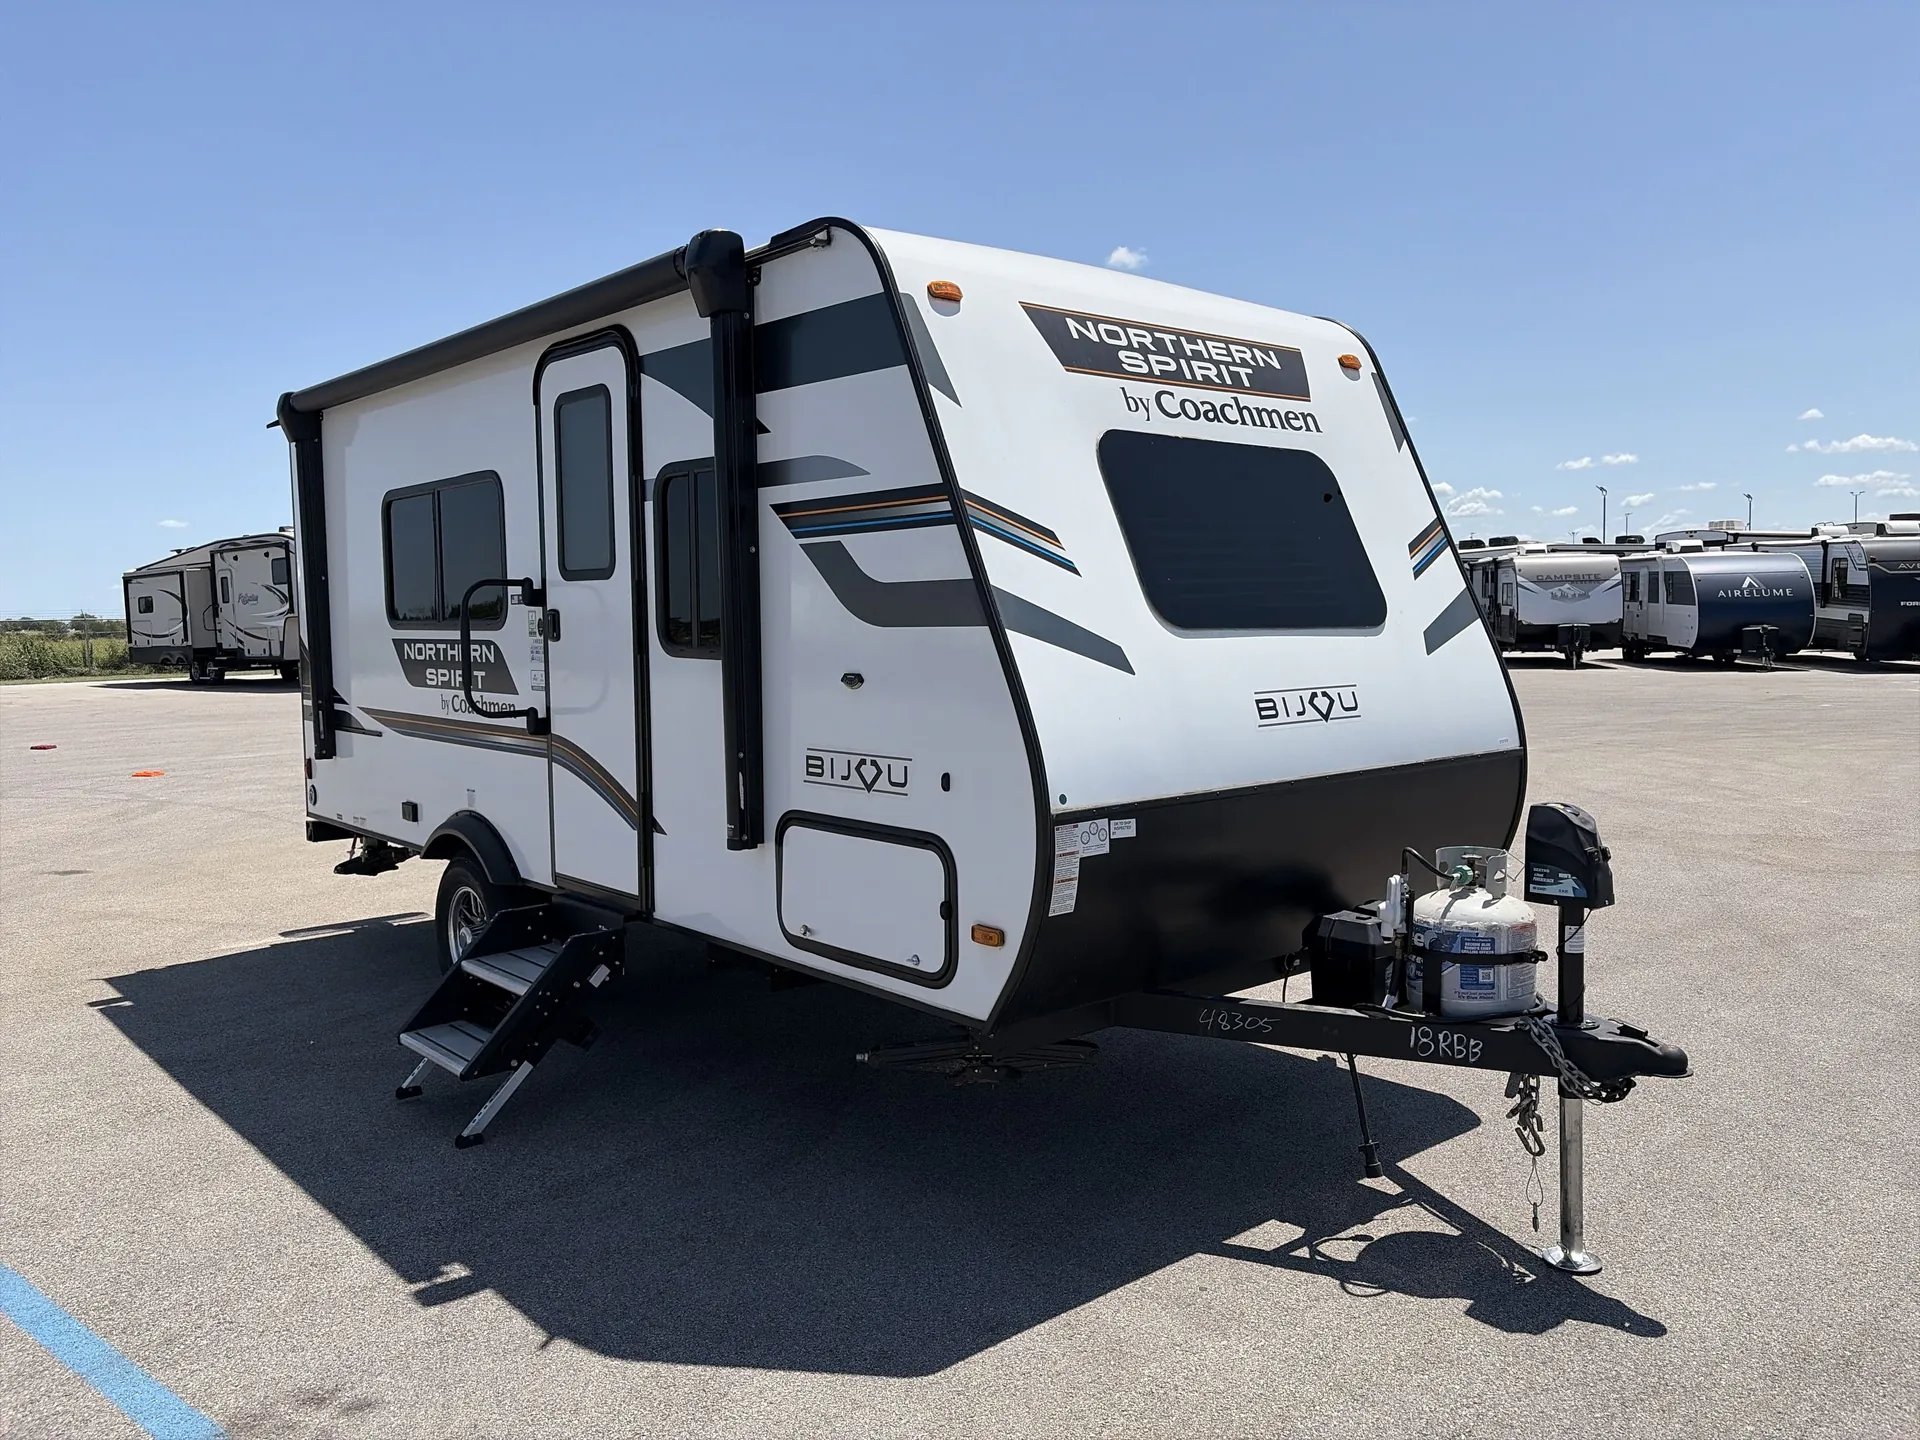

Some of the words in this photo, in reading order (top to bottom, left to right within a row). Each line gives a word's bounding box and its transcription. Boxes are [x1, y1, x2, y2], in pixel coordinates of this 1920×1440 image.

[1065, 317, 1282, 370] NORTHERN
[1118, 350, 1253, 387] SPIRIT
[1119, 387, 1151, 421] by
[1154, 390, 1323, 433] Coachmen
[1536, 573, 1602, 581] CAMPSITE
[1717, 588, 1794, 598] AIRELUME
[404, 643, 495, 663] NORTHRN
[440, 694, 450, 715] by
[1255, 691, 1358, 722] BIJOU
[806, 755, 908, 793] BIJOU
[1199, 1009, 1281, 1033] 48305
[1410, 1026, 1483, 1064] 18RBB
